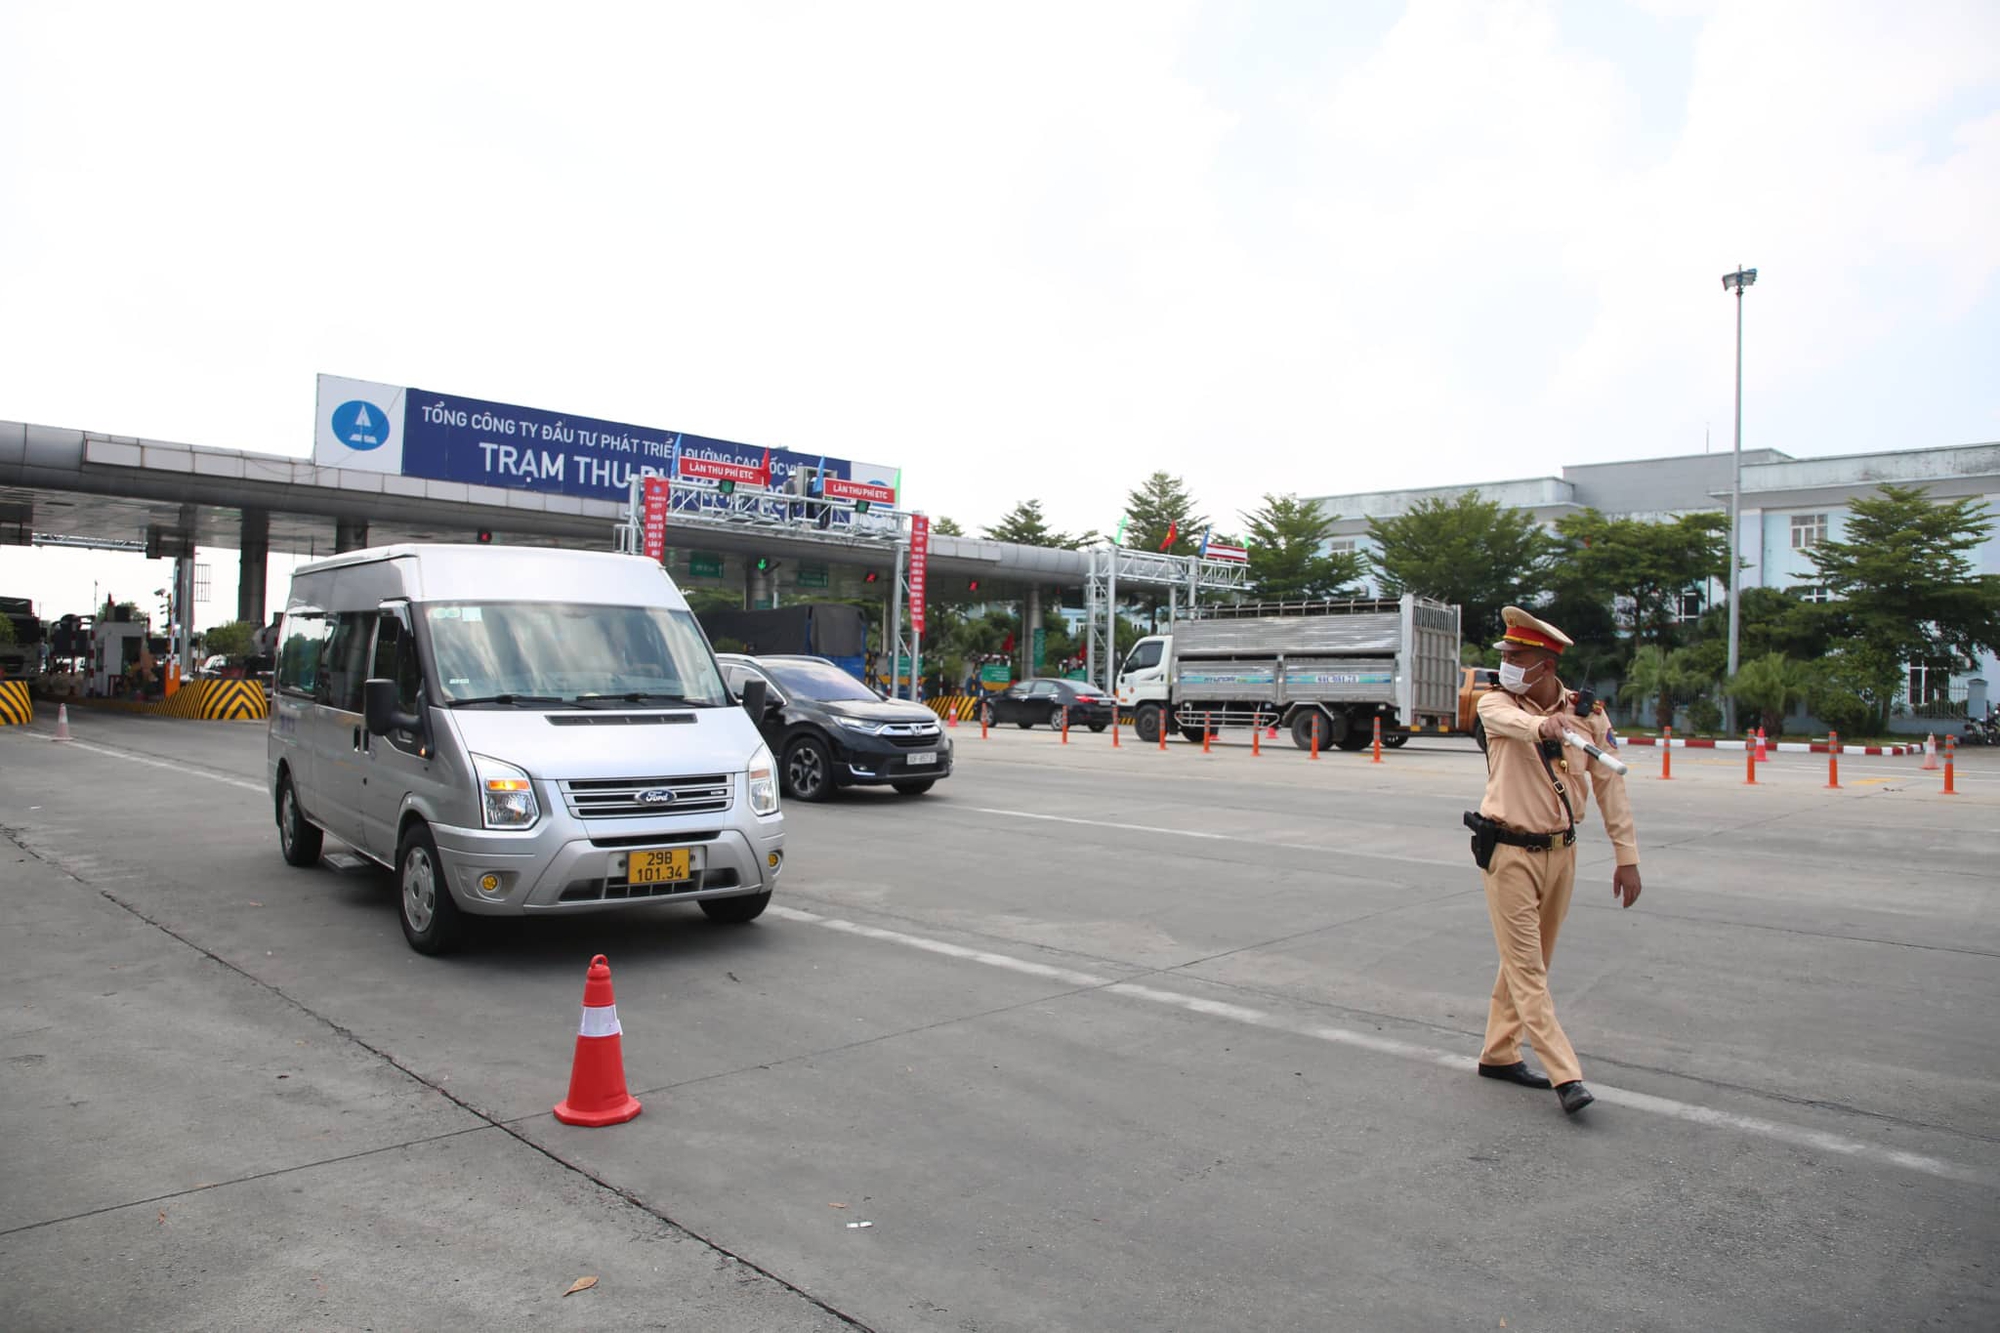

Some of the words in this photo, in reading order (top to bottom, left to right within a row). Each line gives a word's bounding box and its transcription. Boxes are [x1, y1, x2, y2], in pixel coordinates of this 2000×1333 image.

[422, 401, 467, 427] TỔNG
[471, 412, 515, 435] CÔNG
[519, 421, 539, 438] TY
[542, 421, 574, 443] ĐẦU
[578, 430, 598, 446] TƯ
[601, 433, 640, 453] PHÁT
[479, 441, 565, 483] TRẠM
[573, 455, 631, 488] THU
[689, 461, 706, 473] LÀN
[708, 465, 724, 475] THU
[724, 466, 739, 478] PHÍ
[739, 470, 754, 480] ETC
[833, 482, 848, 493] LÀN
[849, 485, 862, 494] THU
[863, 487, 874, 496] PHÍ
[874, 490, 889, 500] ETC
[646, 790, 668, 802] Ford
[647, 852, 673, 866] 29B
[637, 865, 682, 882] 101.34
